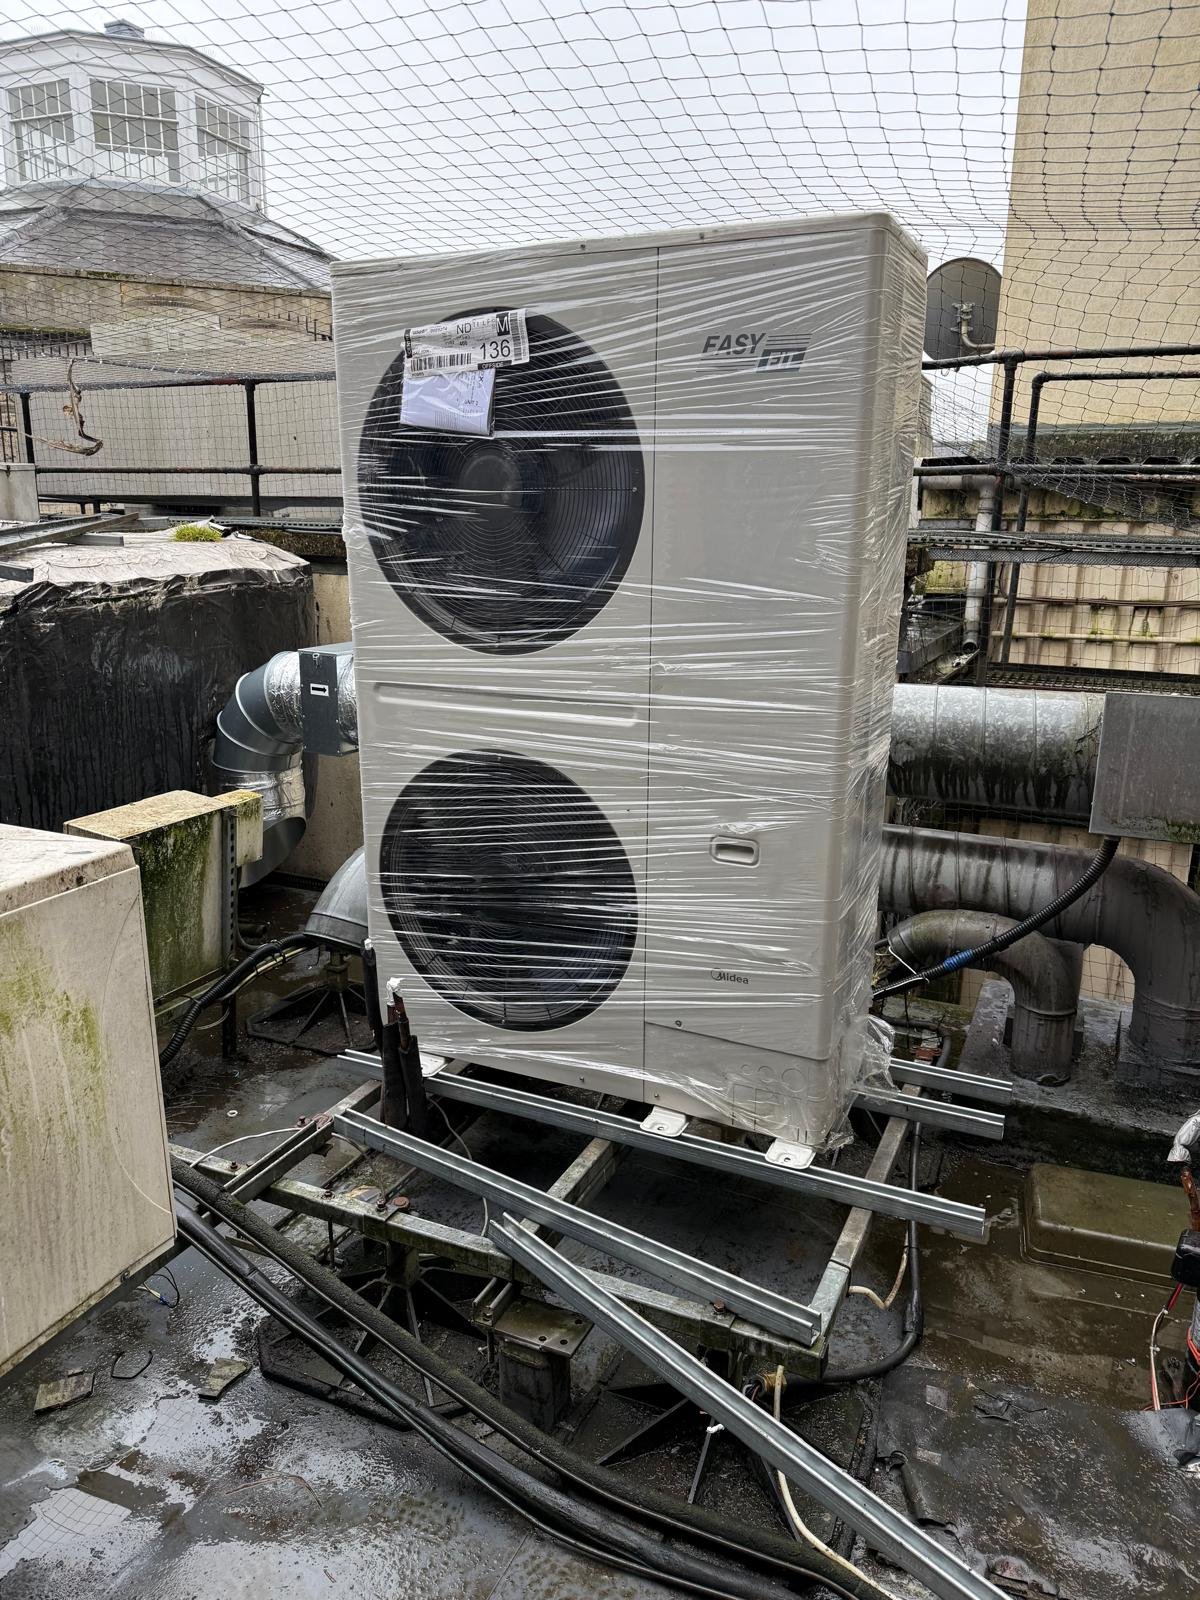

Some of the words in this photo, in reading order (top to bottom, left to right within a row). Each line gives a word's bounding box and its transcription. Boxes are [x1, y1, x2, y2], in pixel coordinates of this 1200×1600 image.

[496, 316, 509, 333] M
[479, 339, 511, 360] 136
[702, 332, 767, 356] EASY
[711, 968, 749, 985] Midea
